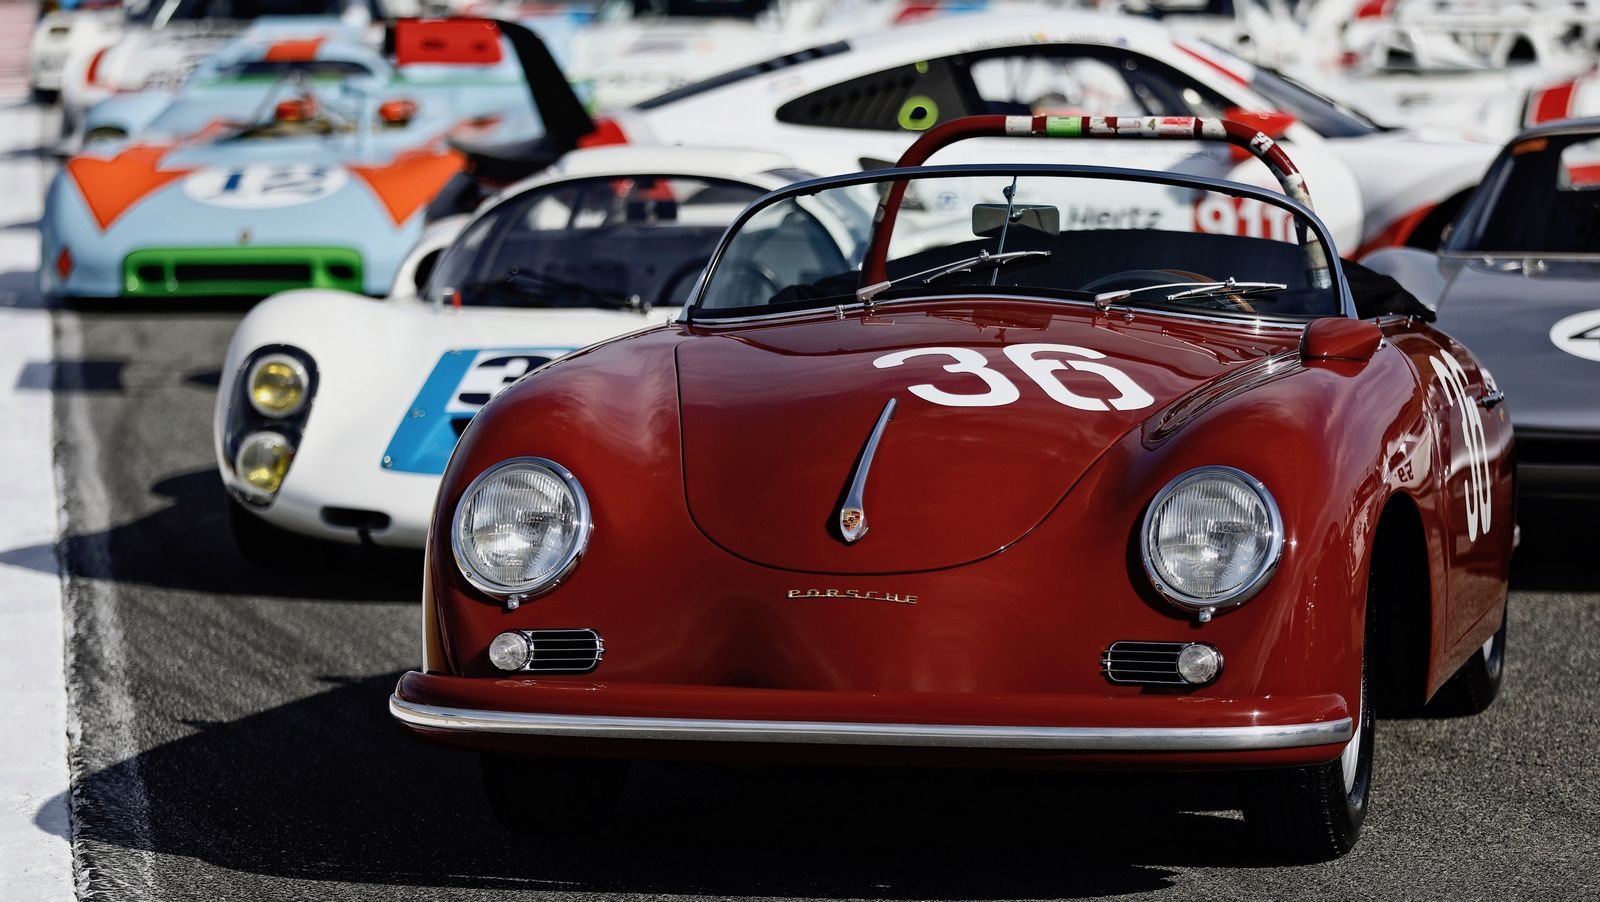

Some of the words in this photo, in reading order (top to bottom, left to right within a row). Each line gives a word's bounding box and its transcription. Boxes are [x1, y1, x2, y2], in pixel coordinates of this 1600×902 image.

[218, 164, 328, 196] 12
[1066, 203, 1163, 230] Hertz
[872, 343, 1155, 411] 36
[1429, 349, 1491, 543] 36
[787, 588, 918, 604] PORSCHE
